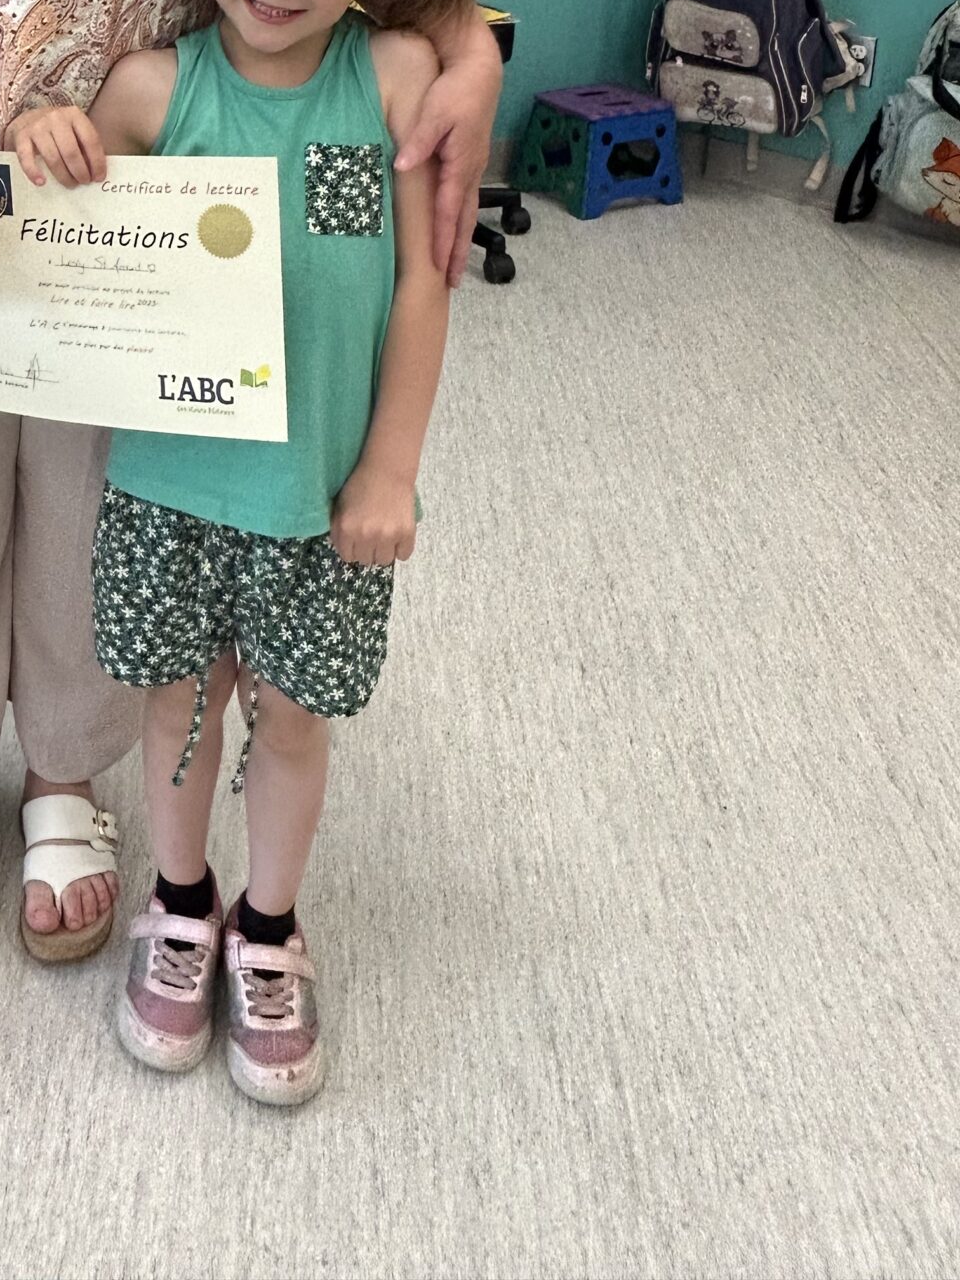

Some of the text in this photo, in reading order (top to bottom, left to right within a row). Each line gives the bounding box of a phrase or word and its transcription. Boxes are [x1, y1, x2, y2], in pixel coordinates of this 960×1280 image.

[102, 181, 259, 195] Certificat de lecture
[20, 218, 189, 249] Félicitations
[158, 374, 234, 405] L'ABC
